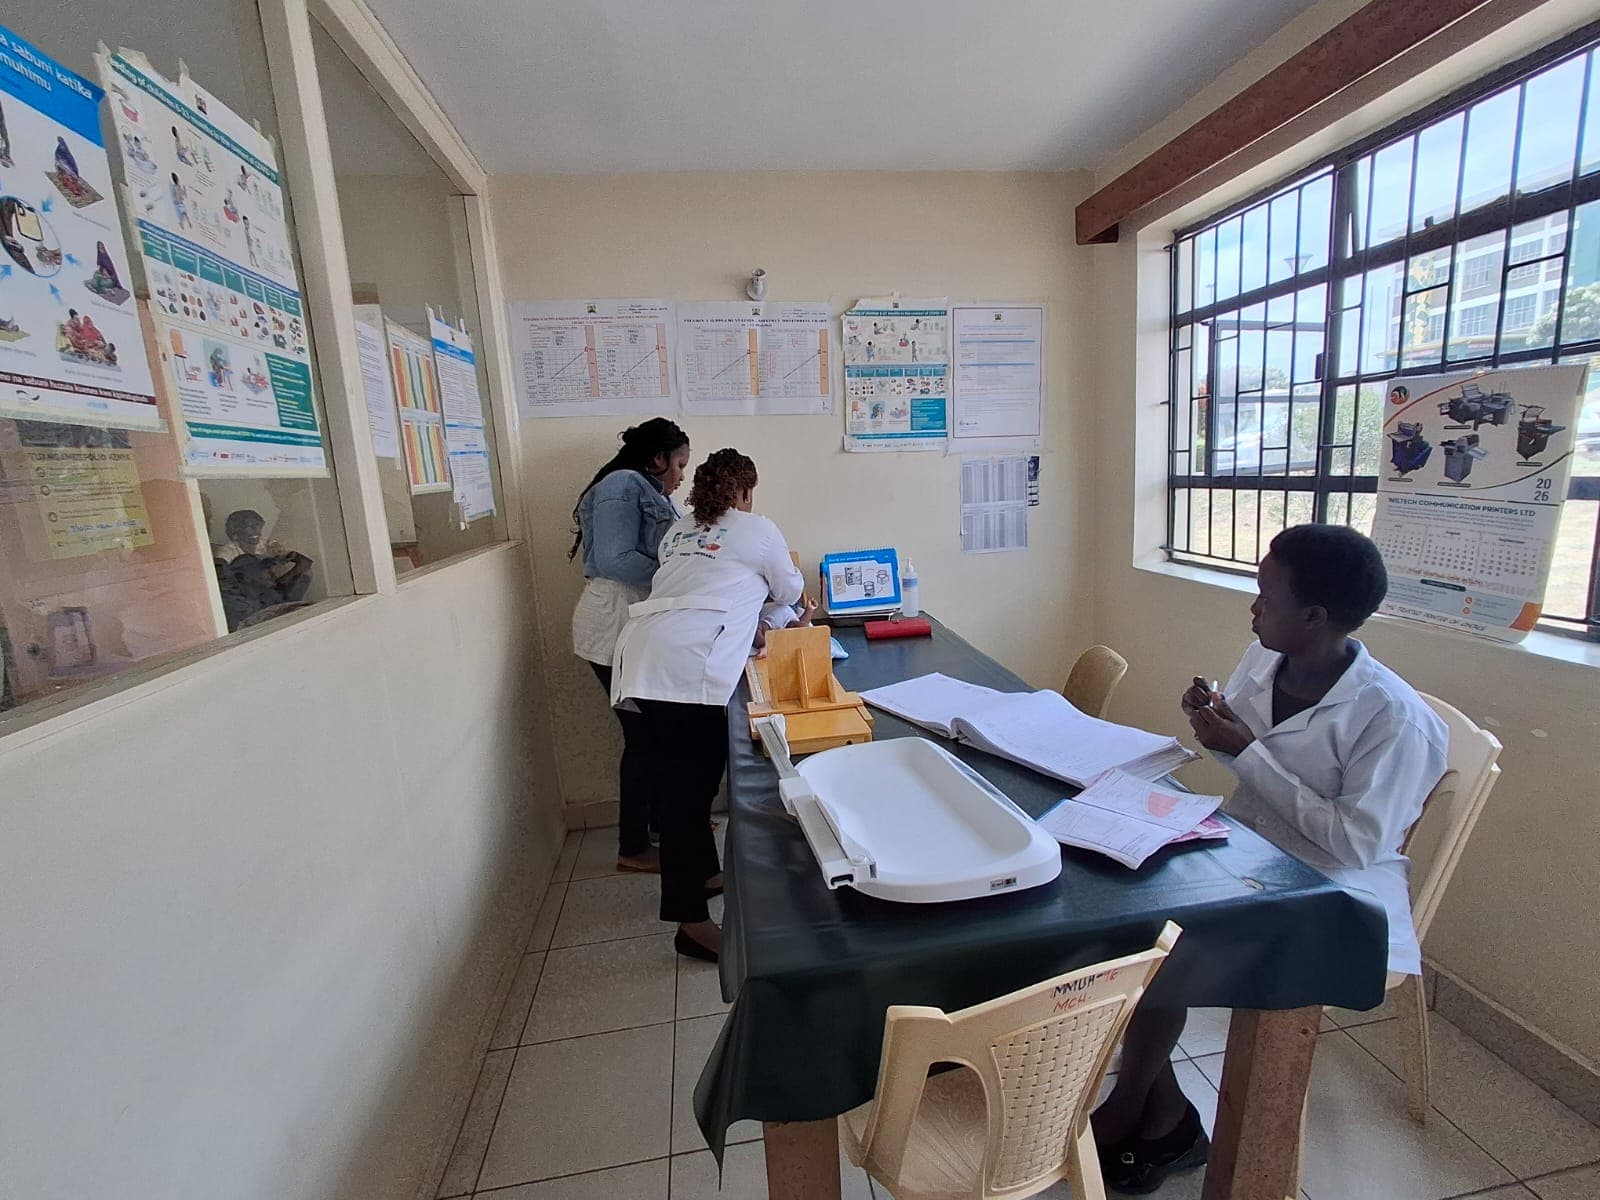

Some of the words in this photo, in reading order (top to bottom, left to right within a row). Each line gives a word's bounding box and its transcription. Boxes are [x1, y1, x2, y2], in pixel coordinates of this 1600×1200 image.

[0, 52, 52, 91] muhimu
[11, 42, 53, 75] sabuni
[55, 68, 92, 99] katika
[1536, 478, 1551, 489] 20
[1534, 490, 1549, 501] 26
[1418, 499, 1481, 511] COMMUNICATION
[1482, 504, 1518, 515] PRINTERS
[1519, 509, 1536, 517] LTD
[1053, 992, 1087, 1012] MCH
